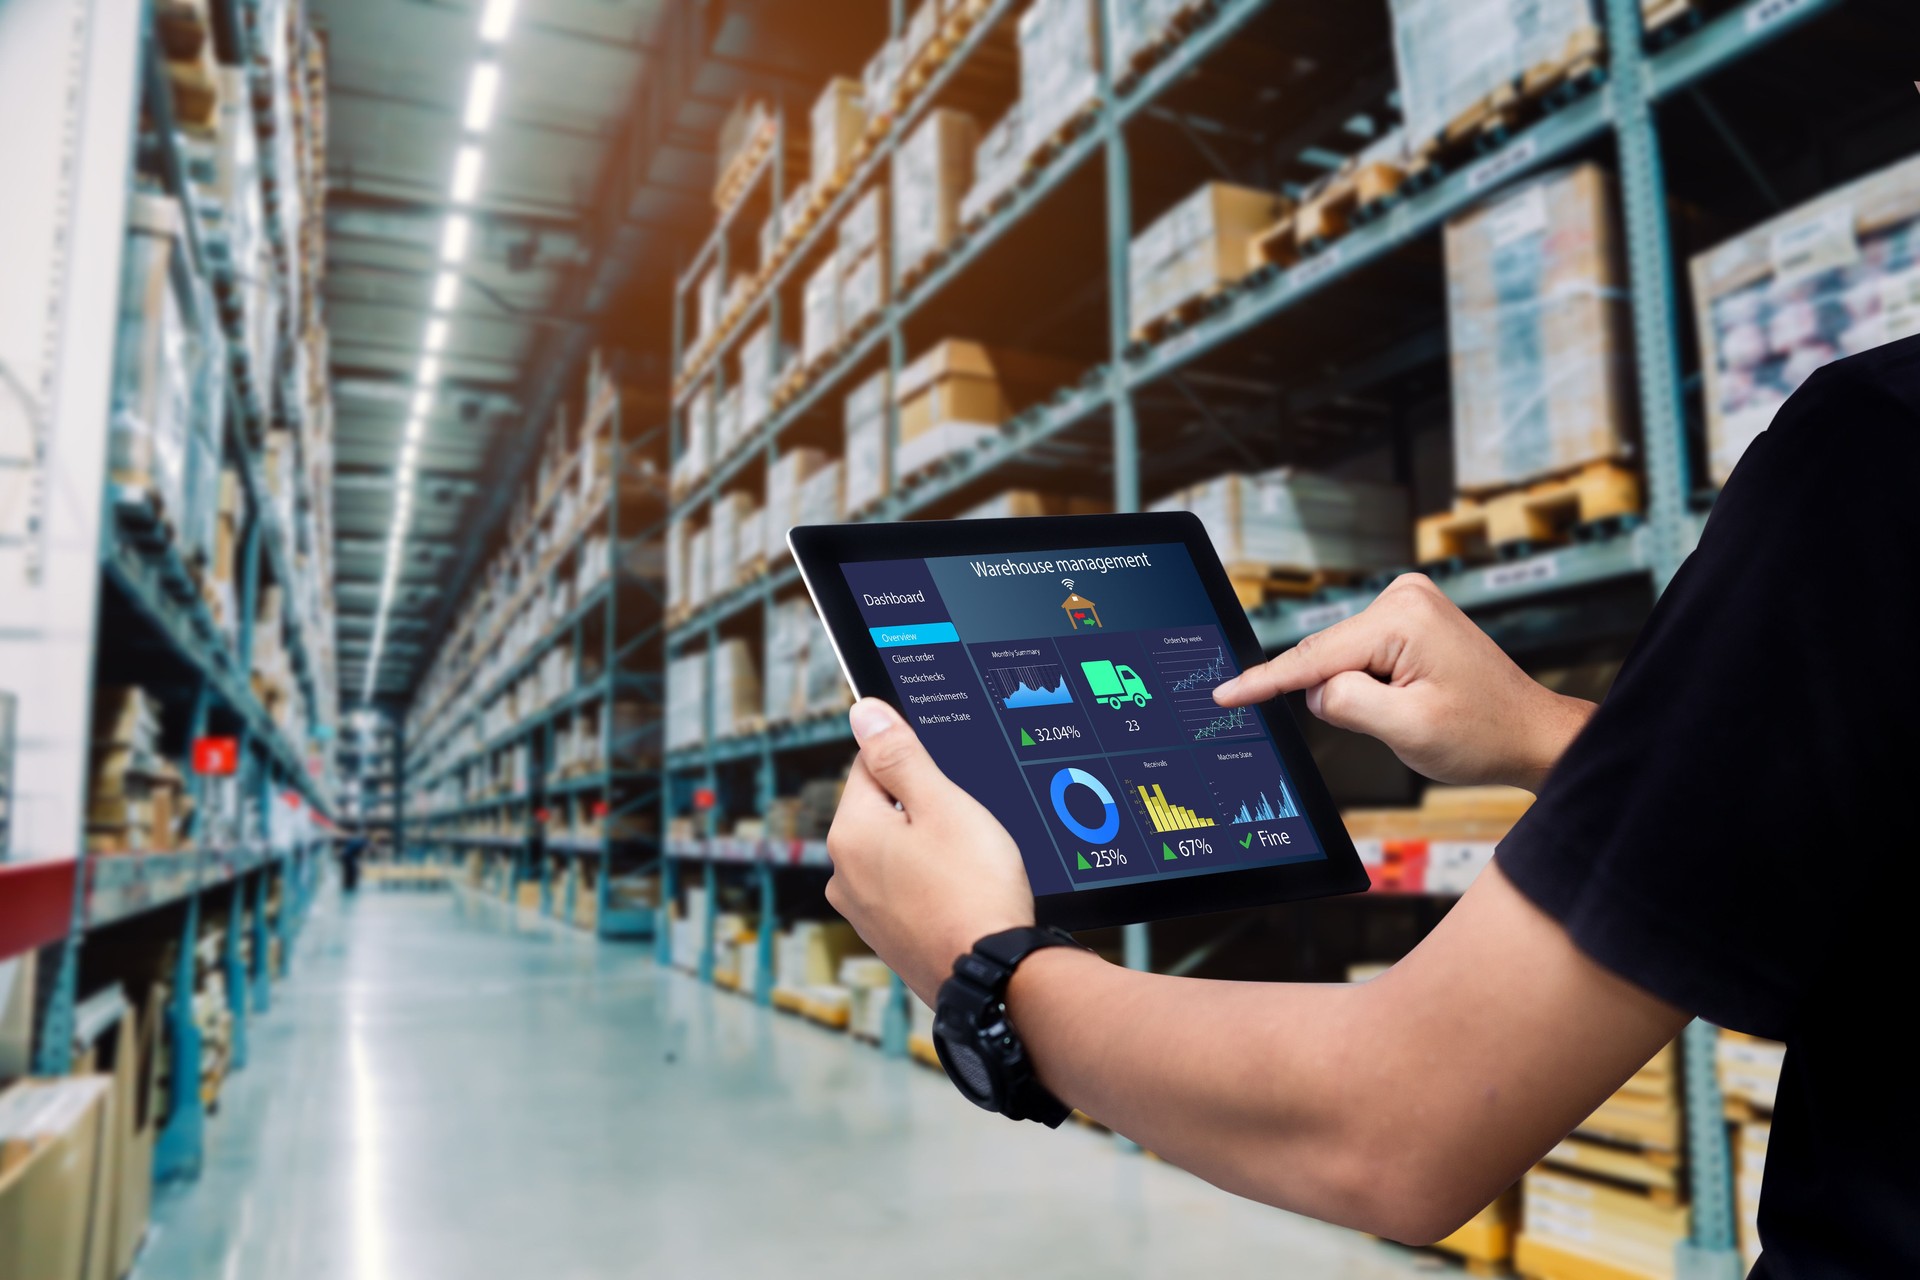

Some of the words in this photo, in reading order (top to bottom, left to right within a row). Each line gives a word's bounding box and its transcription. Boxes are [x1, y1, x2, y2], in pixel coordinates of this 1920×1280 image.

[970, 559, 1055, 577] Warehouse
[1056, 552, 1152, 574] management
[863, 590, 926, 607] Dashboard
[882, 633, 917, 643] Overview
[1163, 637, 1181, 645] Orders
[1180, 636, 1189, 645] by
[1189, 635, 1203, 643] week
[915, 652, 935, 662] order
[991, 650, 1014, 658] Monthly
[1014, 649, 1041, 657] Summary
[900, 672, 946, 684] Stockchecks
[909, 692, 969, 705] Replenishments
[918, 714, 952, 725] Machine
[951, 712, 971, 722] State
[1125, 719, 1141, 732] 23
[1034, 725, 1081, 742] 32.04%
[1217, 752, 1239, 760] Machine
[1238, 751, 1253, 759] State
[1257, 830, 1292, 847] Fine
[1178, 838, 1213, 857] 67%
[1090, 848, 1128, 868] 25%
